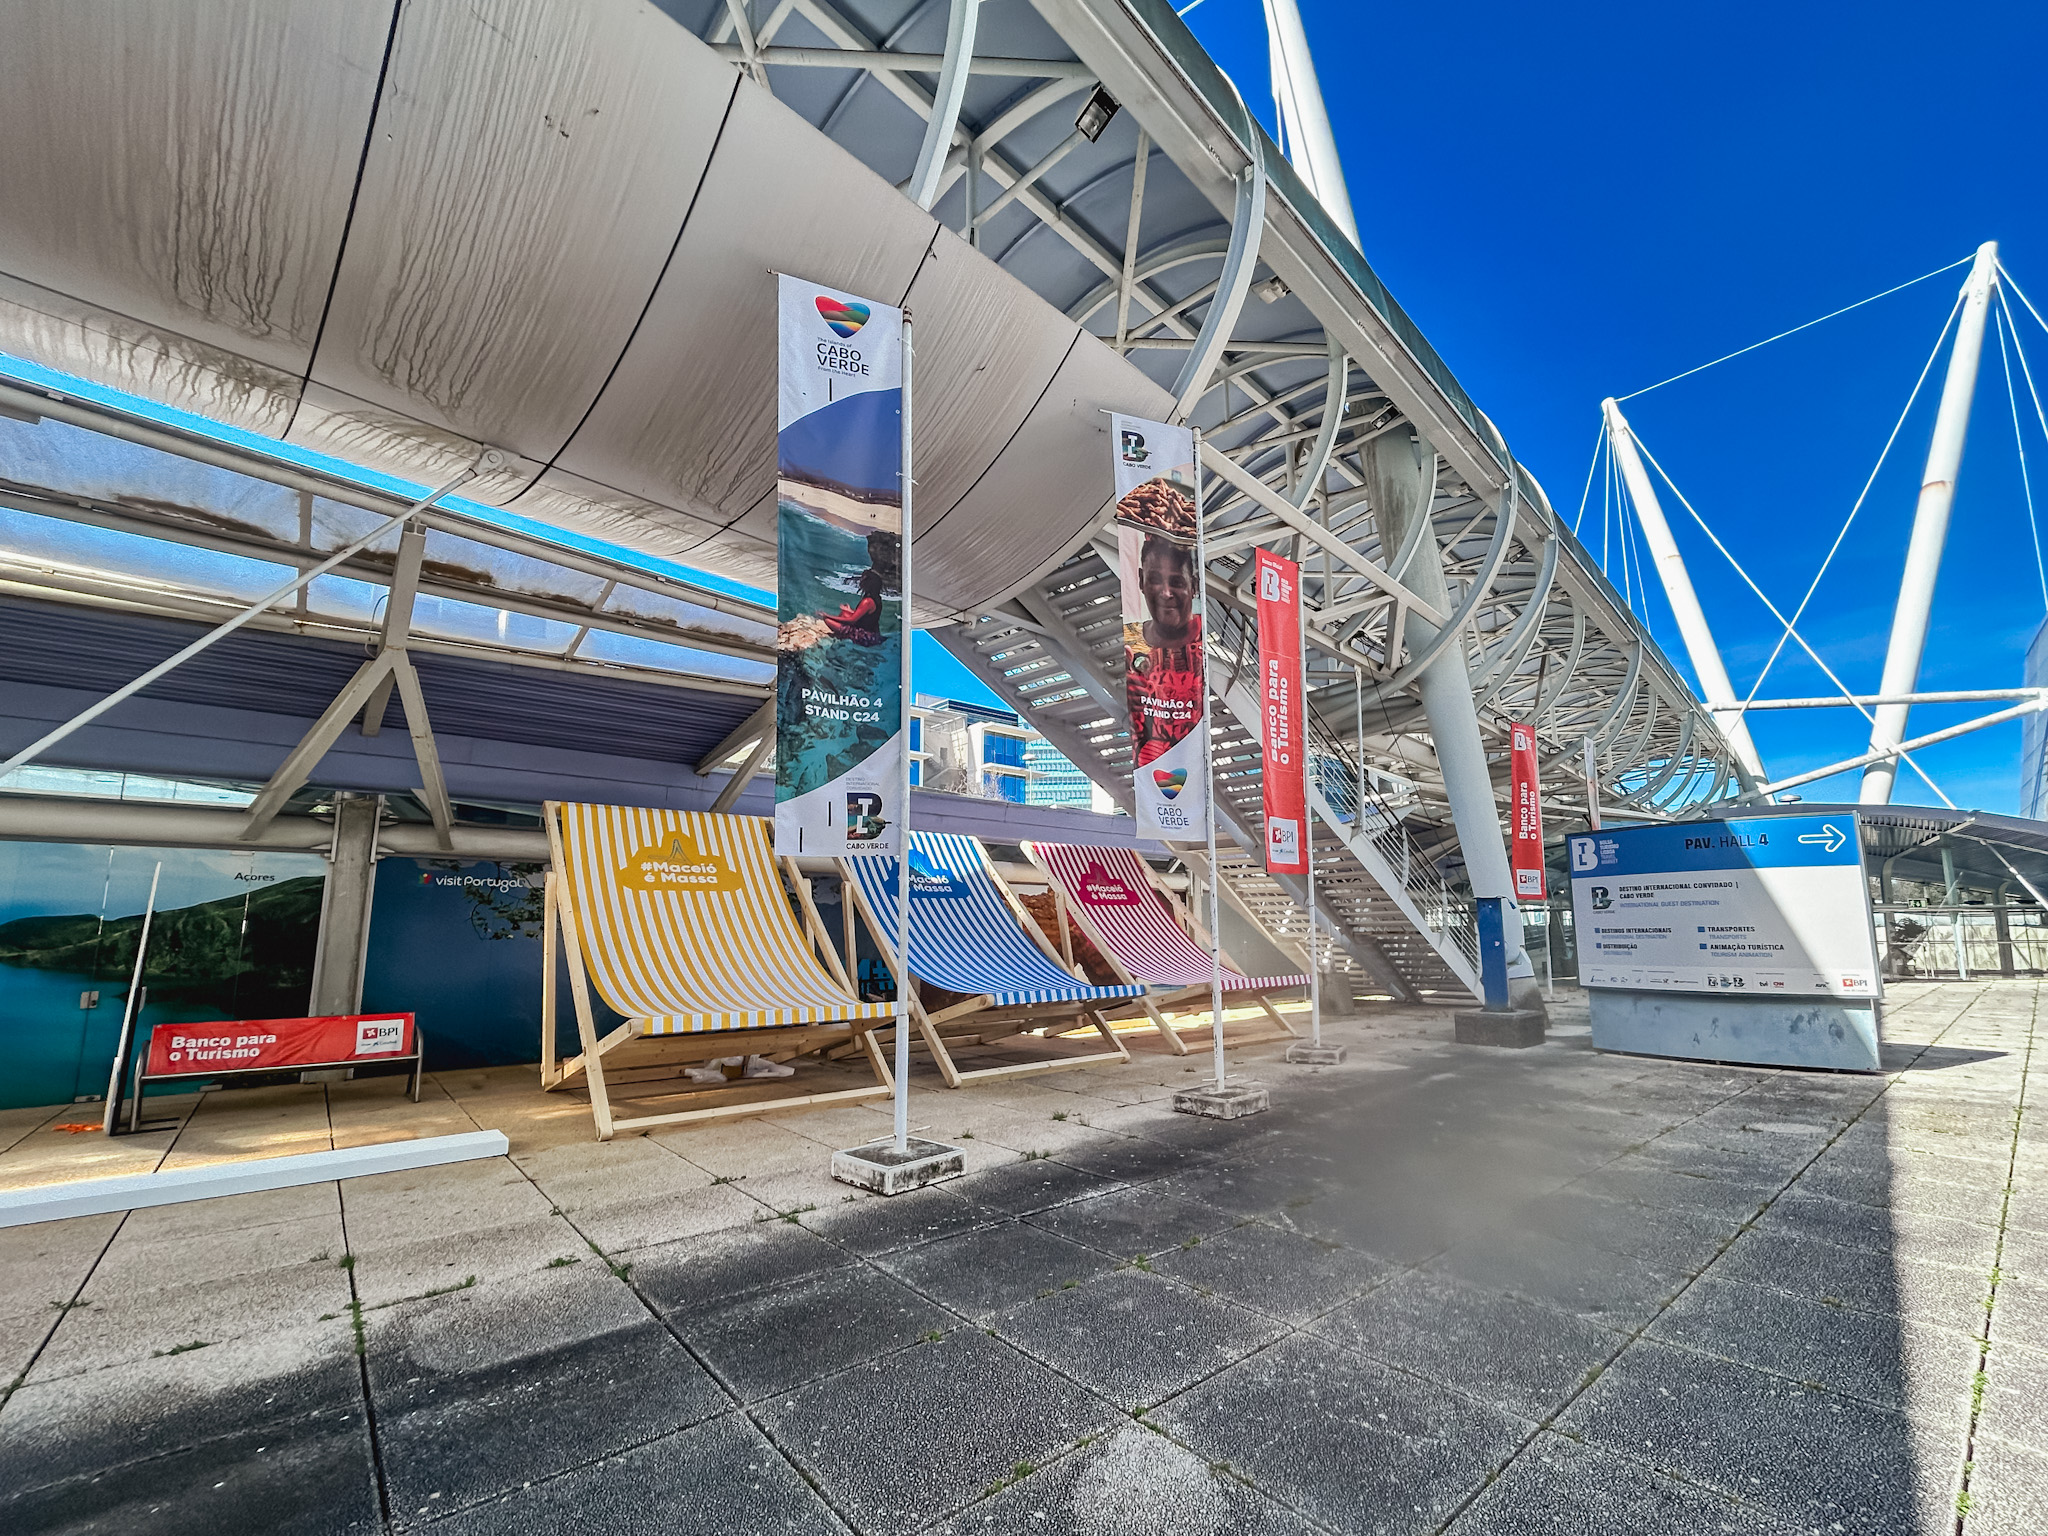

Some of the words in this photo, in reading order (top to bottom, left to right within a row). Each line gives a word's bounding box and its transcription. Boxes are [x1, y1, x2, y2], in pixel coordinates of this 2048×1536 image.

[817, 343, 862, 361] CABO
[817, 354, 870, 376] VERDE
[1268, 660, 1279, 700] para
[801, 688, 870, 708] PAVILHÃO
[874, 698, 883, 708] 4
[1140, 696, 1184, 709] PAVILHÃO
[1186, 700, 1193, 708] 4
[804, 704, 850, 721] STAND
[852, 711, 880, 722] C24
[1144, 708, 1170, 719] STAND
[1172, 711, 1192, 720] C24
[1277, 677, 1289, 749] Turismo
[1280, 753, 1289, 764] o
[1520, 782, 1529, 804] para
[1157, 806, 1182, 816] CABO
[1528, 791, 1536, 832] Turismo
[1158, 816, 1190, 826] VERDE
[1519, 807, 1528, 838] Banco
[1282, 830, 1294, 842] BPI
[1685, 837, 1715, 850] PAV.
[1720, 835, 1755, 848] HALL
[1758, 833, 1769, 846] 4
[641, 862, 717, 874] #Maceió
[234, 872, 275, 882] Açores
[644, 872, 655, 882] é
[661, 872, 718, 884] Massa
[913, 884, 952, 892] Massa
[1086, 884, 1124, 892] #Maceió
[1098, 892, 1128, 900] Massa
[379, 1027, 398, 1036] BPI
[171, 1035, 230, 1049] Banco
[236, 1034, 276, 1048] para
[169, 1051, 181, 1062] o
[186, 1046, 260, 1060] Turismo
